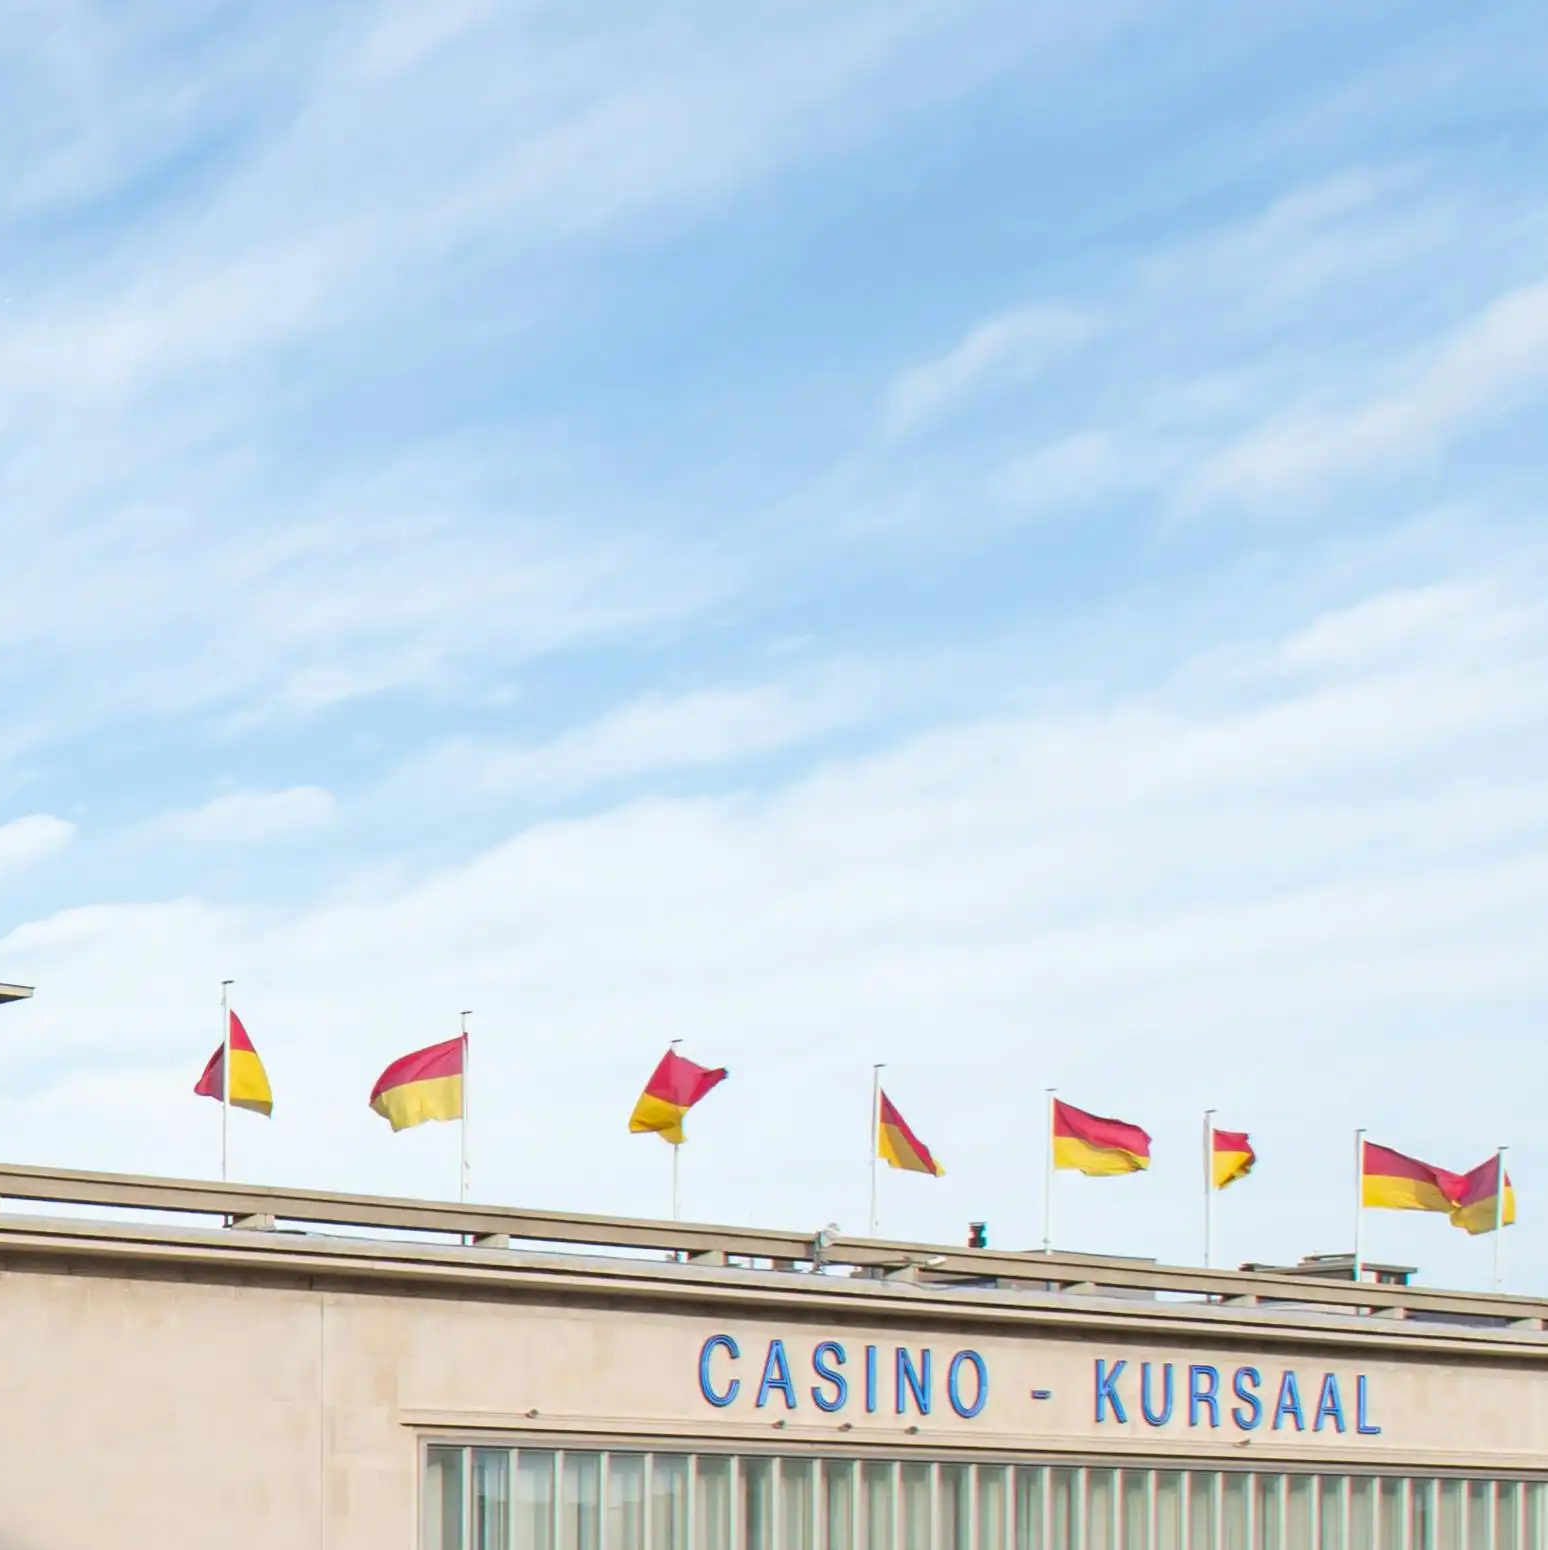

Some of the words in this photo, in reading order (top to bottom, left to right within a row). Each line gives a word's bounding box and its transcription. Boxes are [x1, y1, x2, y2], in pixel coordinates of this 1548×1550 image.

[699, 1333, 988, 1419] CASINO
[1031, 1389, 1052, 1400] -
[1095, 1358, 1381, 1435] KURSAAL
